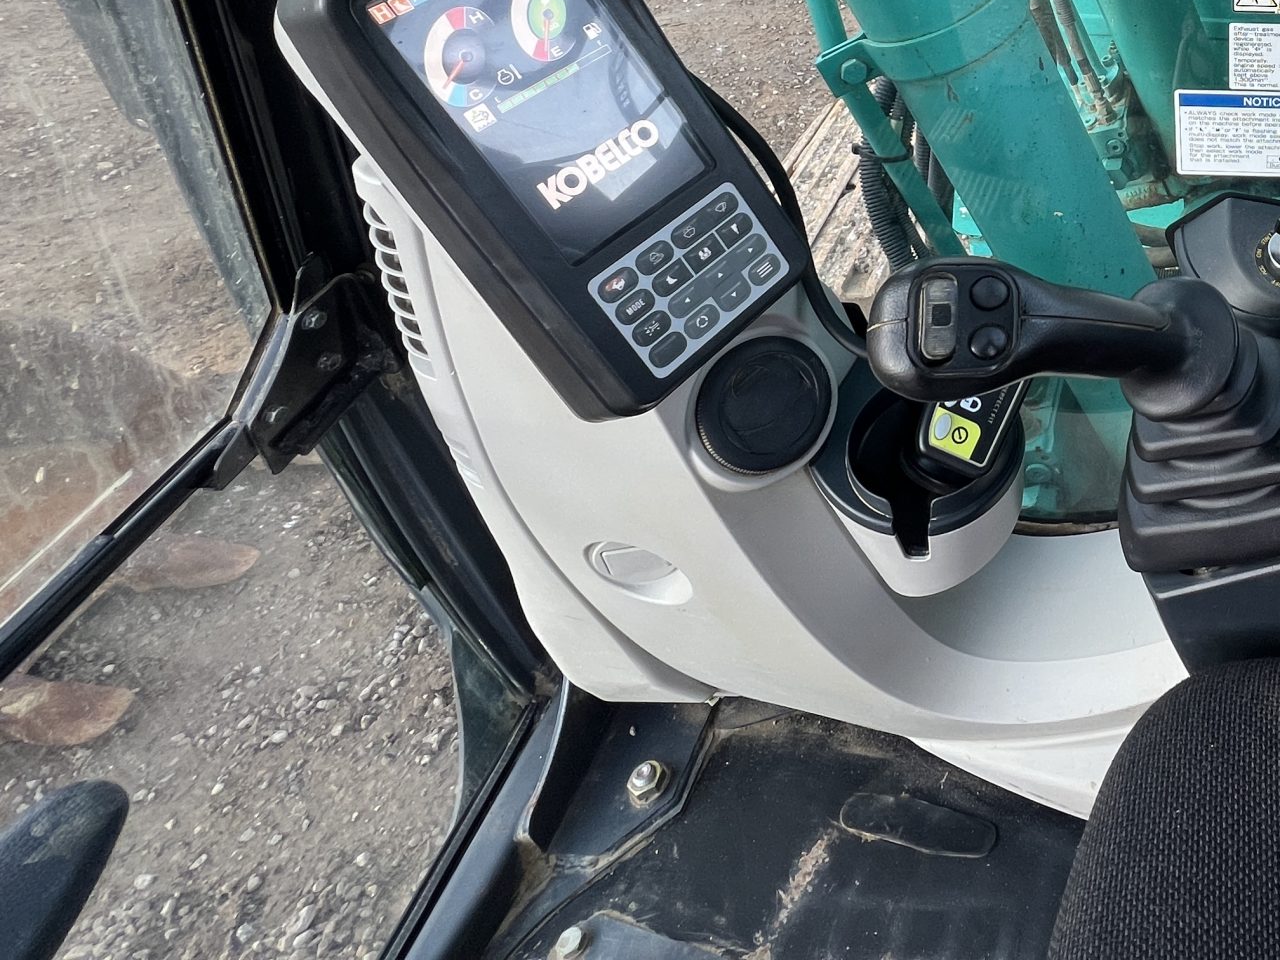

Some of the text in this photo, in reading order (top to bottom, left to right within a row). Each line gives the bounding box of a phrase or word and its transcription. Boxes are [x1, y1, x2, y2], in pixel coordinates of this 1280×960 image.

[468, 11, 484, 24] H
[551, 46, 564, 58] E
[469, 89, 483, 101] C
[536, 119, 659, 210] KOBELCO
[626, 299, 646, 315] MODE
